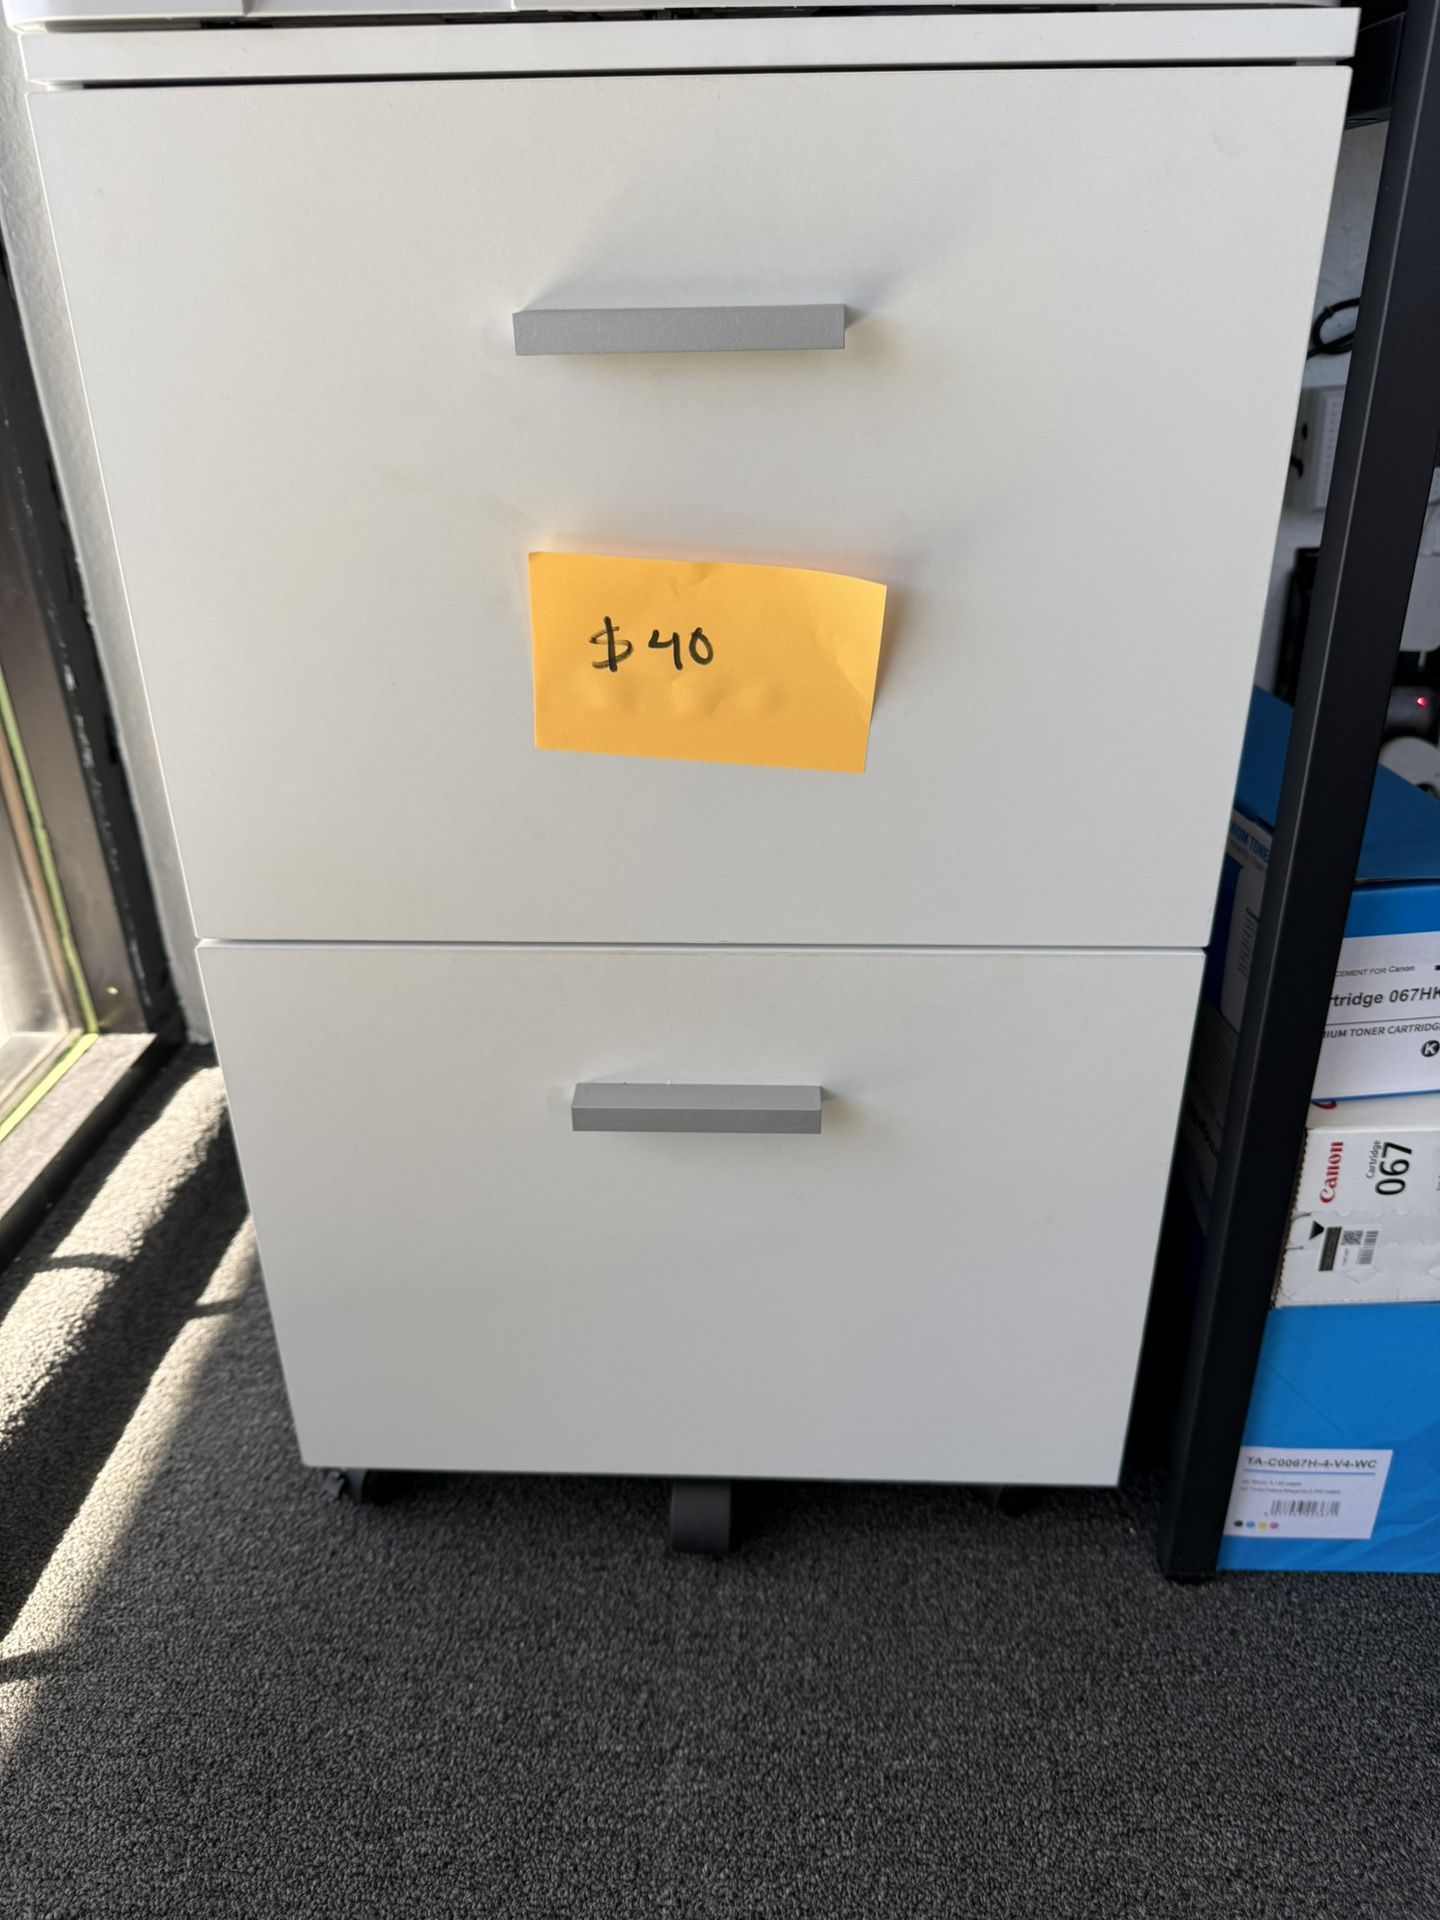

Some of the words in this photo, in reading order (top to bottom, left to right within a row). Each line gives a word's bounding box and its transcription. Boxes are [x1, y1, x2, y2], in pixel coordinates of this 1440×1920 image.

[1369, 967, 1387, 975] FOR
[1388, 965, 1415, 974] Canon
[1350, 1026, 1386, 1037] TONER
[1387, 1022, 1440, 1034] CARTRIDG
[1423, 1041, 1437, 1056] K
[1365, 1140, 1382, 1179] Cartridge
[1319, 1141, 1344, 1203] Canon
[1375, 1141, 1413, 1196] 067
[1246, 1456, 1377, 1469] TA-C0067H-4-V4-WC
